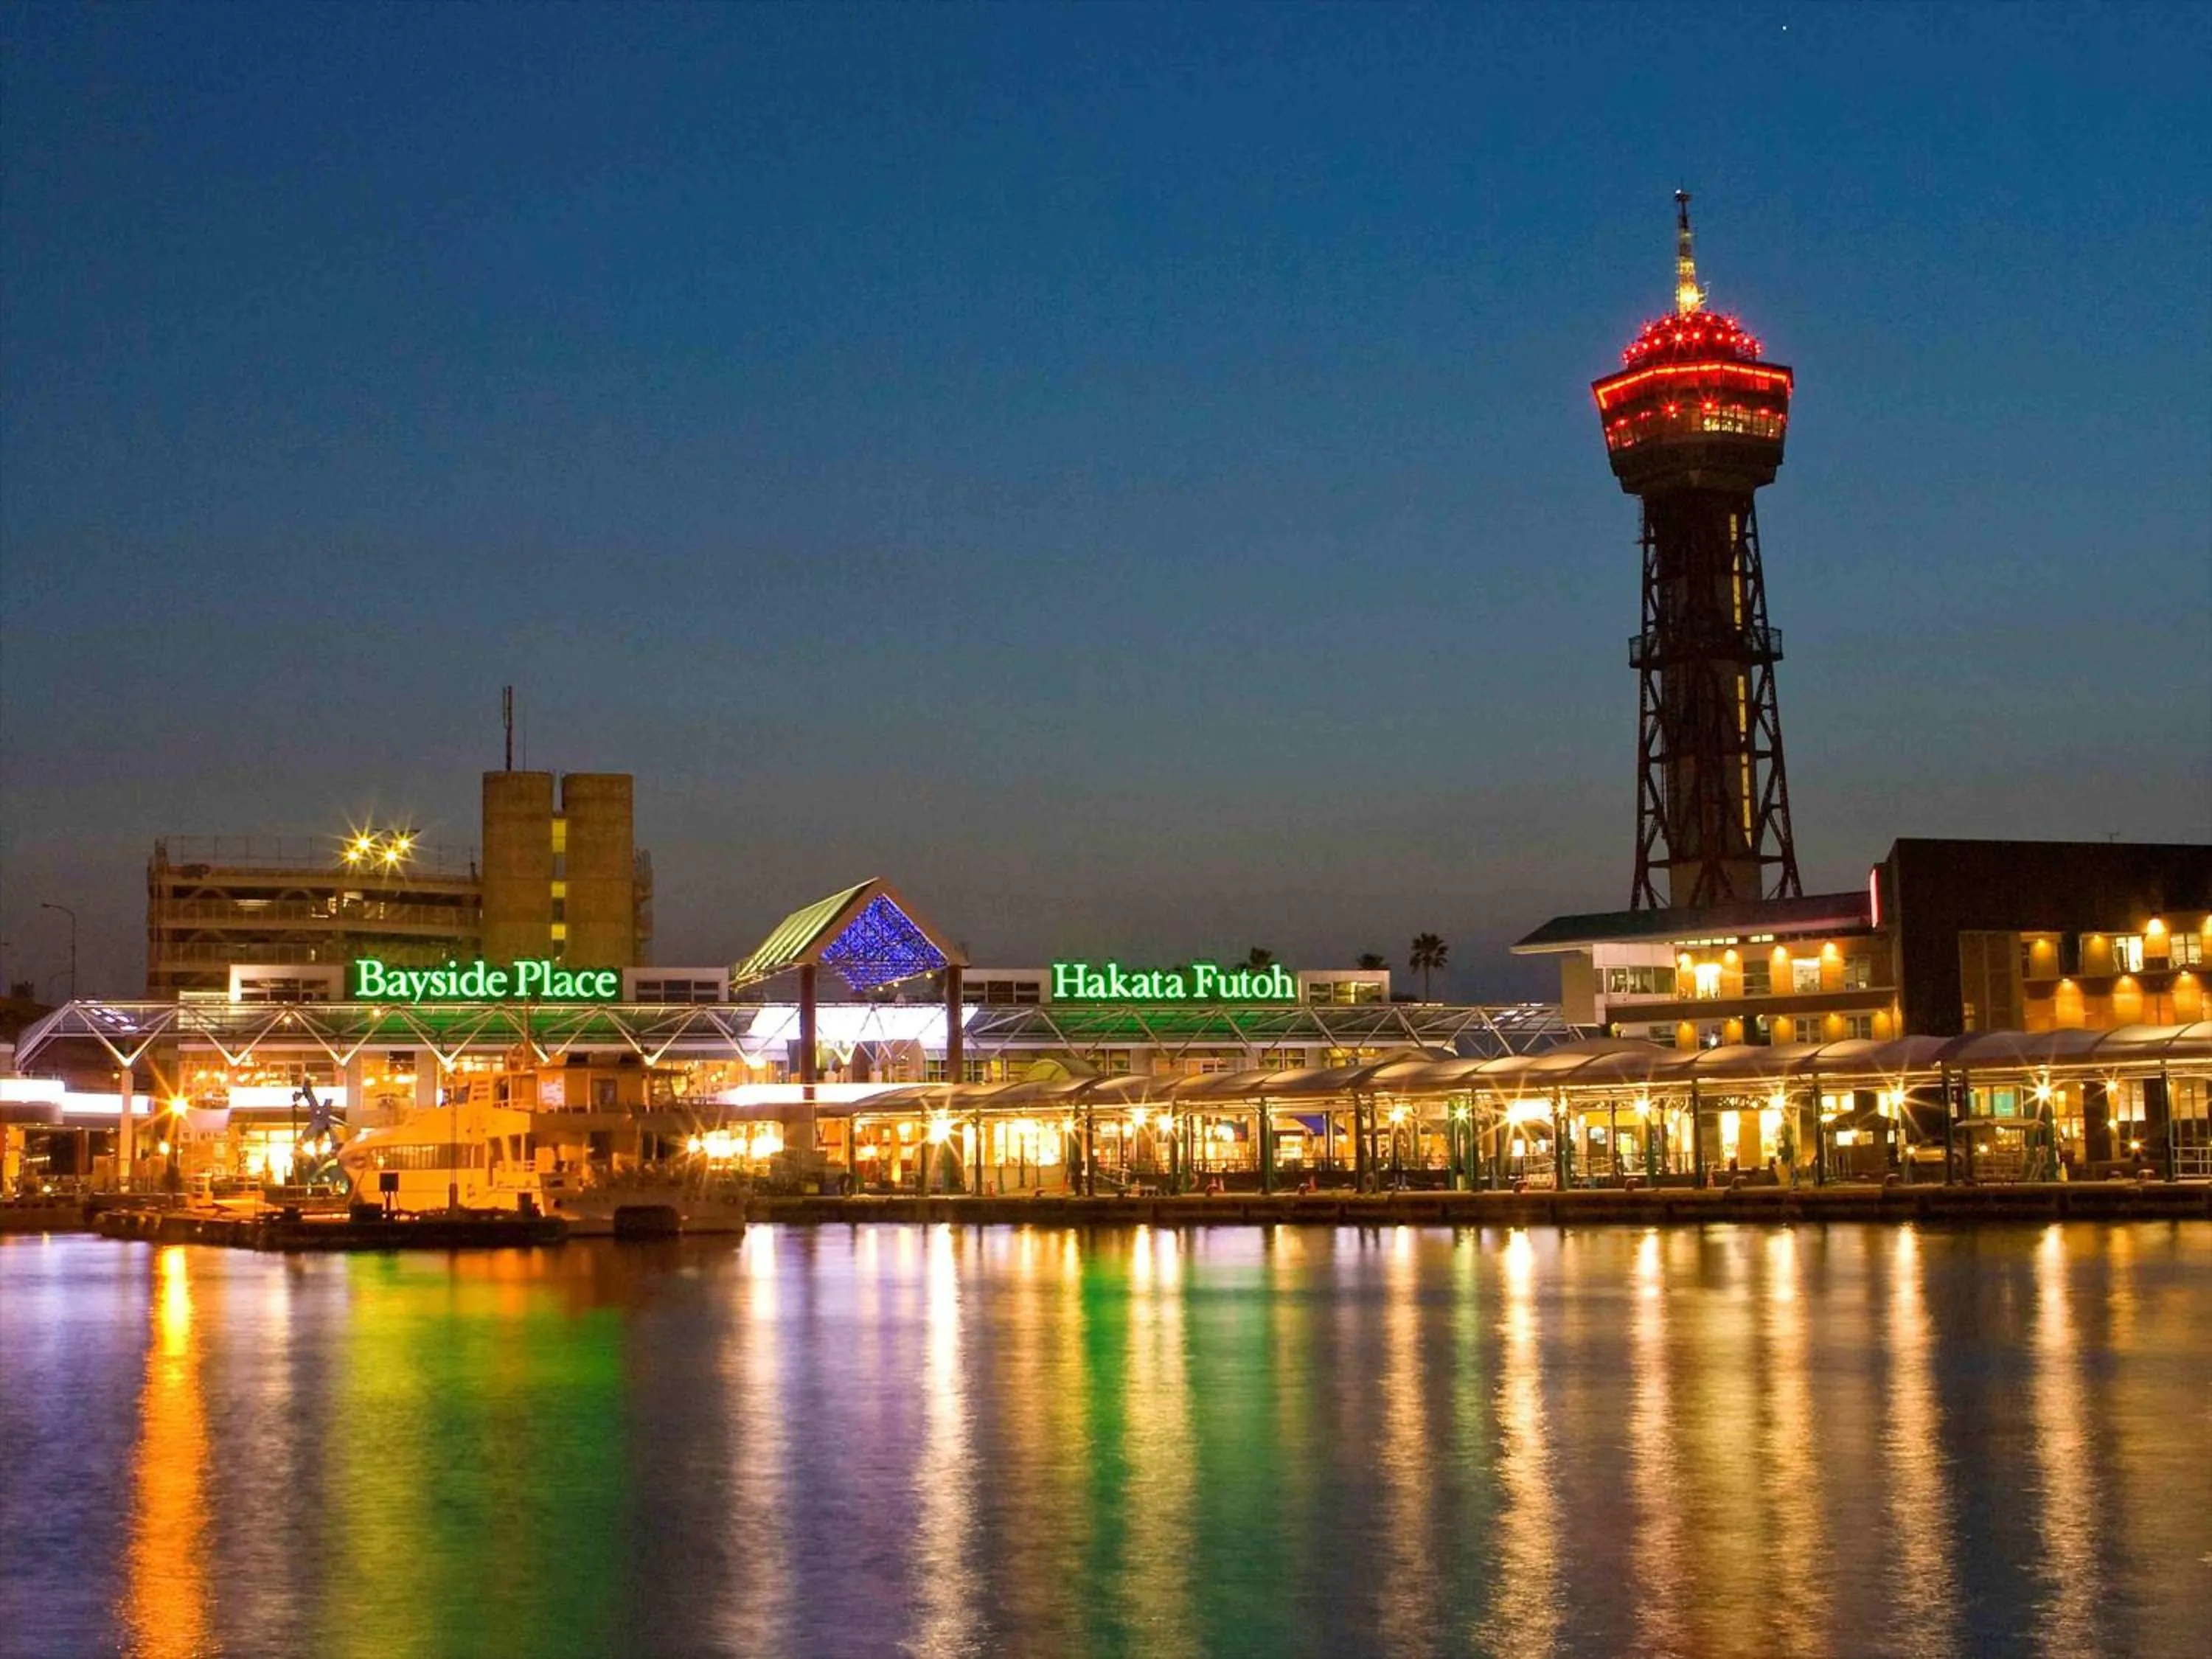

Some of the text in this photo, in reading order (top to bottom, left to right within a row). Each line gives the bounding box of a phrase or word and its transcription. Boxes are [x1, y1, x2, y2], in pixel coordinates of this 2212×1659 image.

[355, 960, 617, 1004] Bayside Place
[1054, 963, 1295, 998] Hakata Futoh
